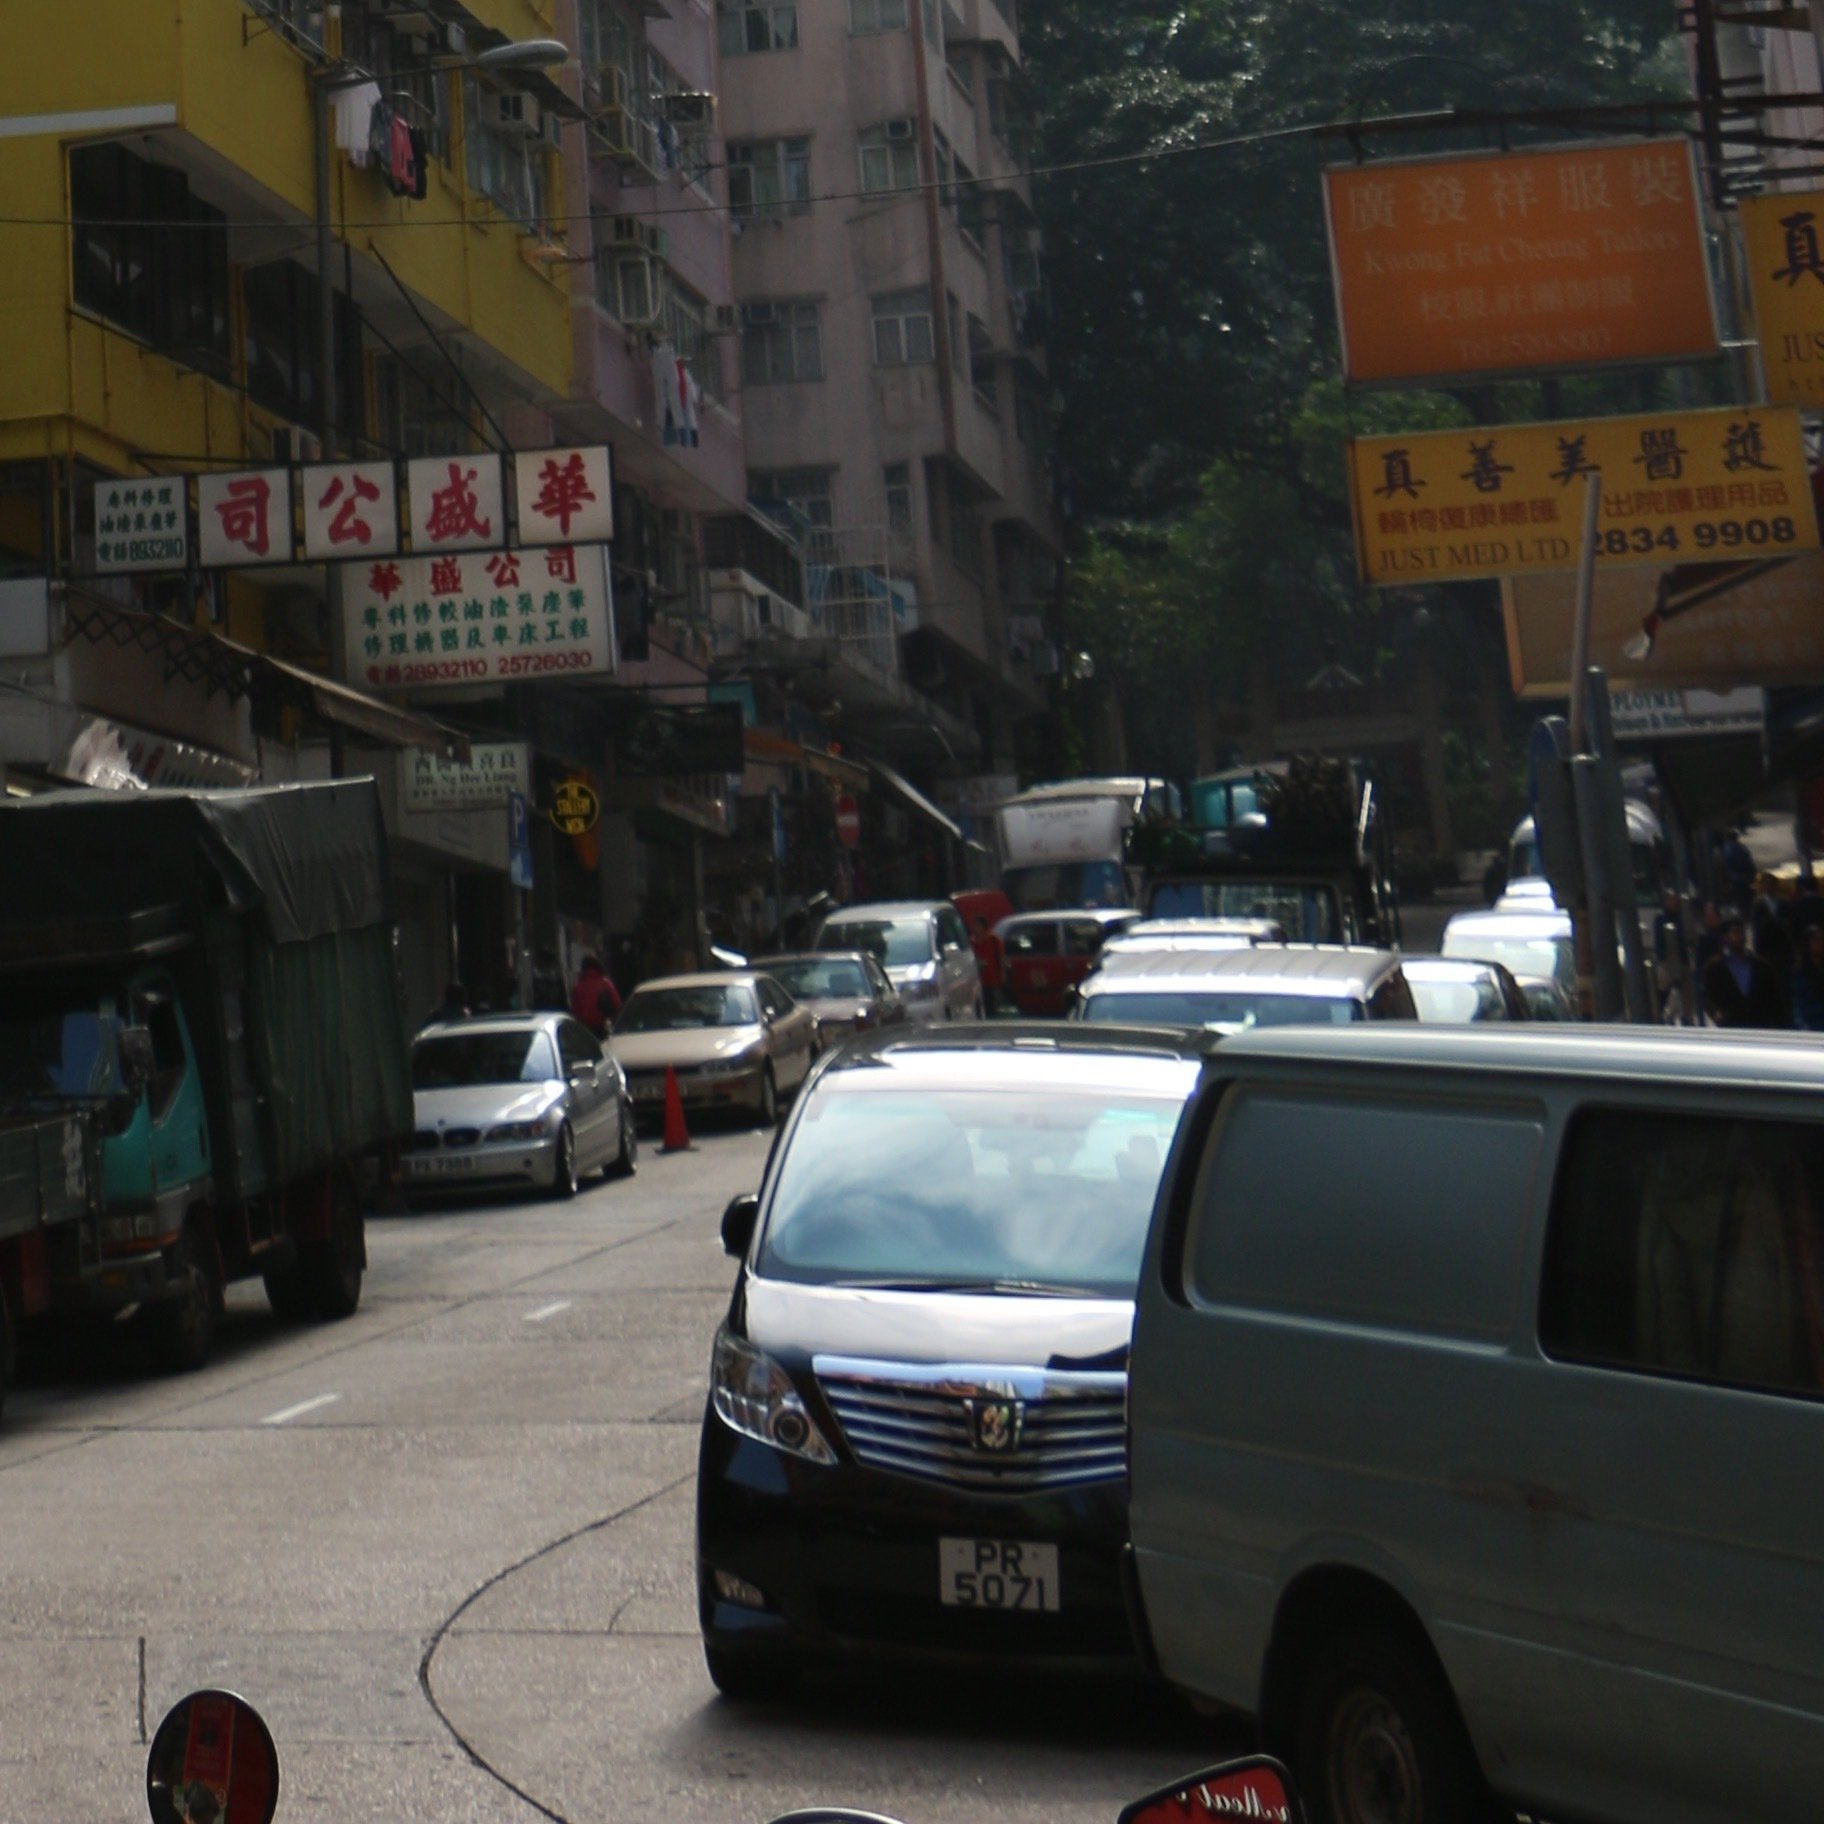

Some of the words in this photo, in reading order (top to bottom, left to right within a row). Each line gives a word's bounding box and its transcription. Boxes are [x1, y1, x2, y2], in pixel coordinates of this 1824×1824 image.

[1348, 155, 1683, 233] 廣發祥服裝
[1373, 419, 1782, 499] 真善美醫護
[1603, 480, 1791, 519] 出院護理用品
[1693, 516, 1797, 549] 9908
[368, 545, 577, 602] 華盛公司
[1379, 543, 1442, 572] JUST
[1447, 540, 1509, 567] MED
[1515, 536, 1570, 563] LTD
[976, 1540, 1024, 1576] PR
[954, 1572, 1045, 1612] 5071
